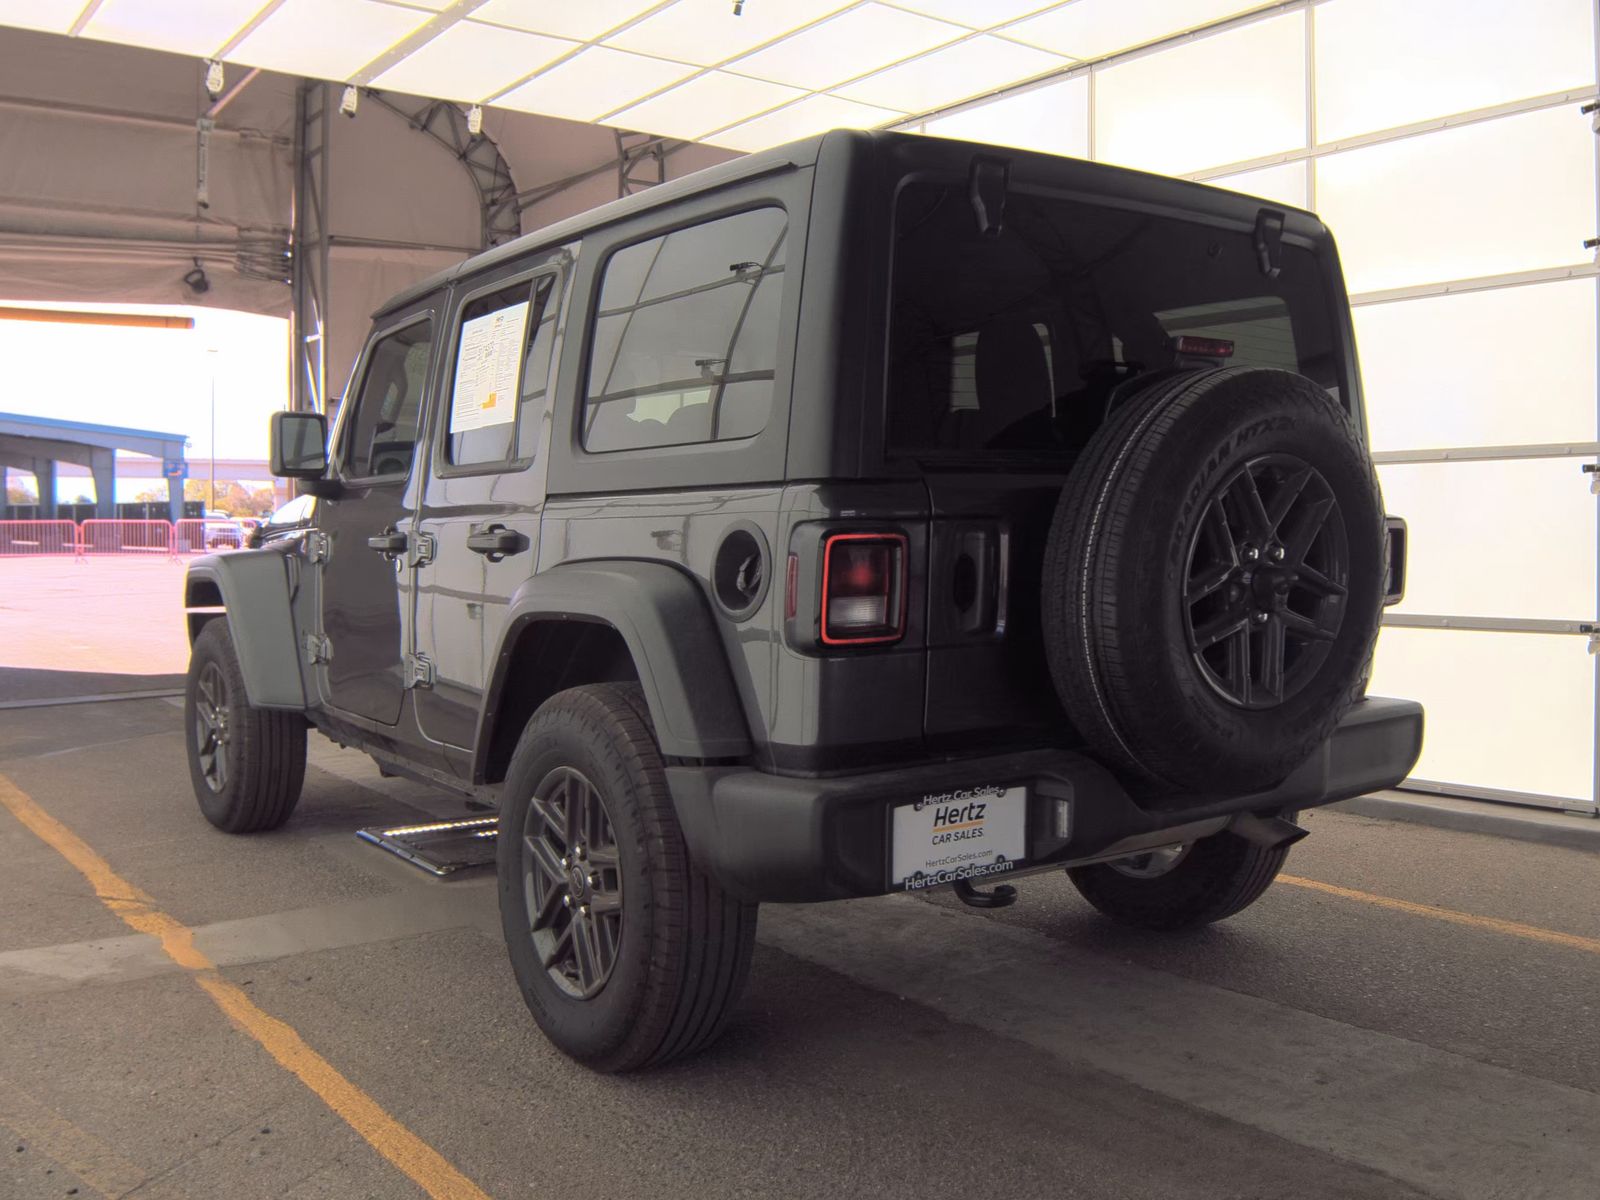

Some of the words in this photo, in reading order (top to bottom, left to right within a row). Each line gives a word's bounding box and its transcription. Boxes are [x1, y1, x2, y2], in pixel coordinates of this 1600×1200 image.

[923, 793, 951, 806] Hertz
[953, 790, 974, 800] Car
[974, 785, 999, 797] Sales
[934, 802, 986, 827] Hertz
[932, 833, 952, 846] CAR
[953, 828, 984, 841] SALES
[925, 849, 993, 868] HertzCarSales.com
[905, 860, 1013, 891] HertzCarSales.com
